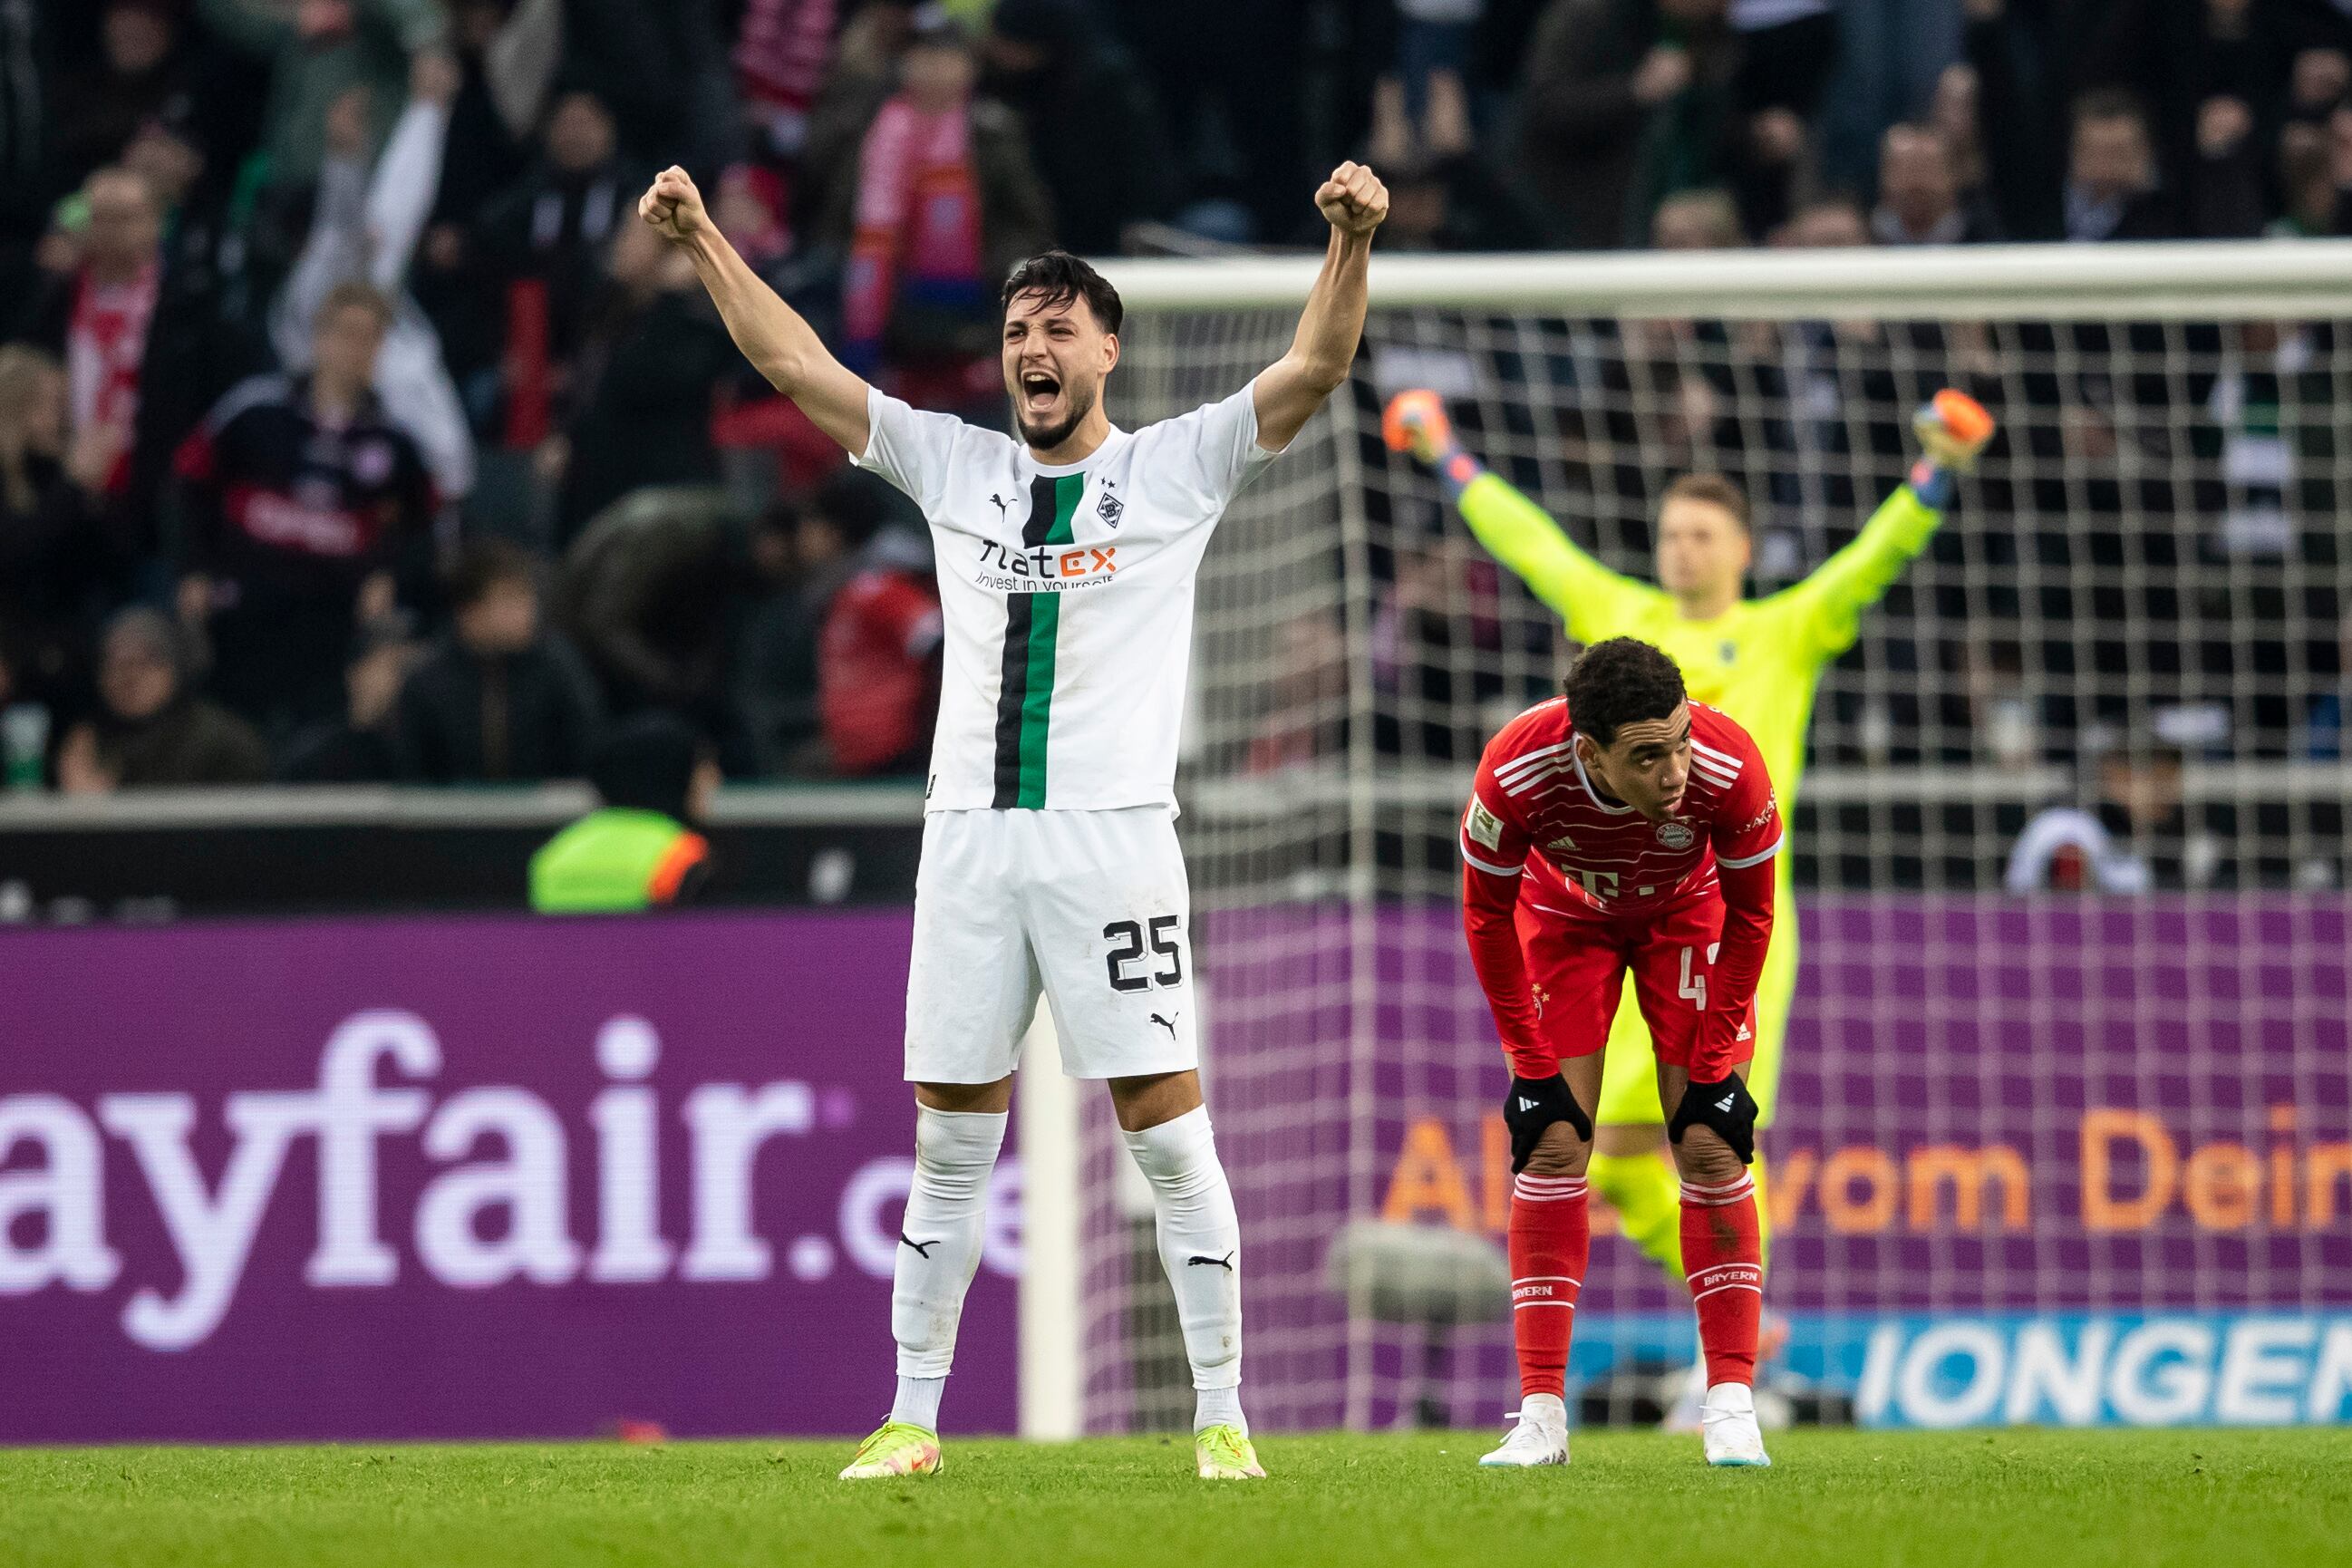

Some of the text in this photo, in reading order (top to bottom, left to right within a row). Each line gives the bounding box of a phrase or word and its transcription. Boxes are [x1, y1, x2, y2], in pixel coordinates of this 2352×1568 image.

[1022, 577, 1039, 592] in
[1102, 915, 1184, 994] 25
[1704, 1272, 1758, 1287] BAYERN
